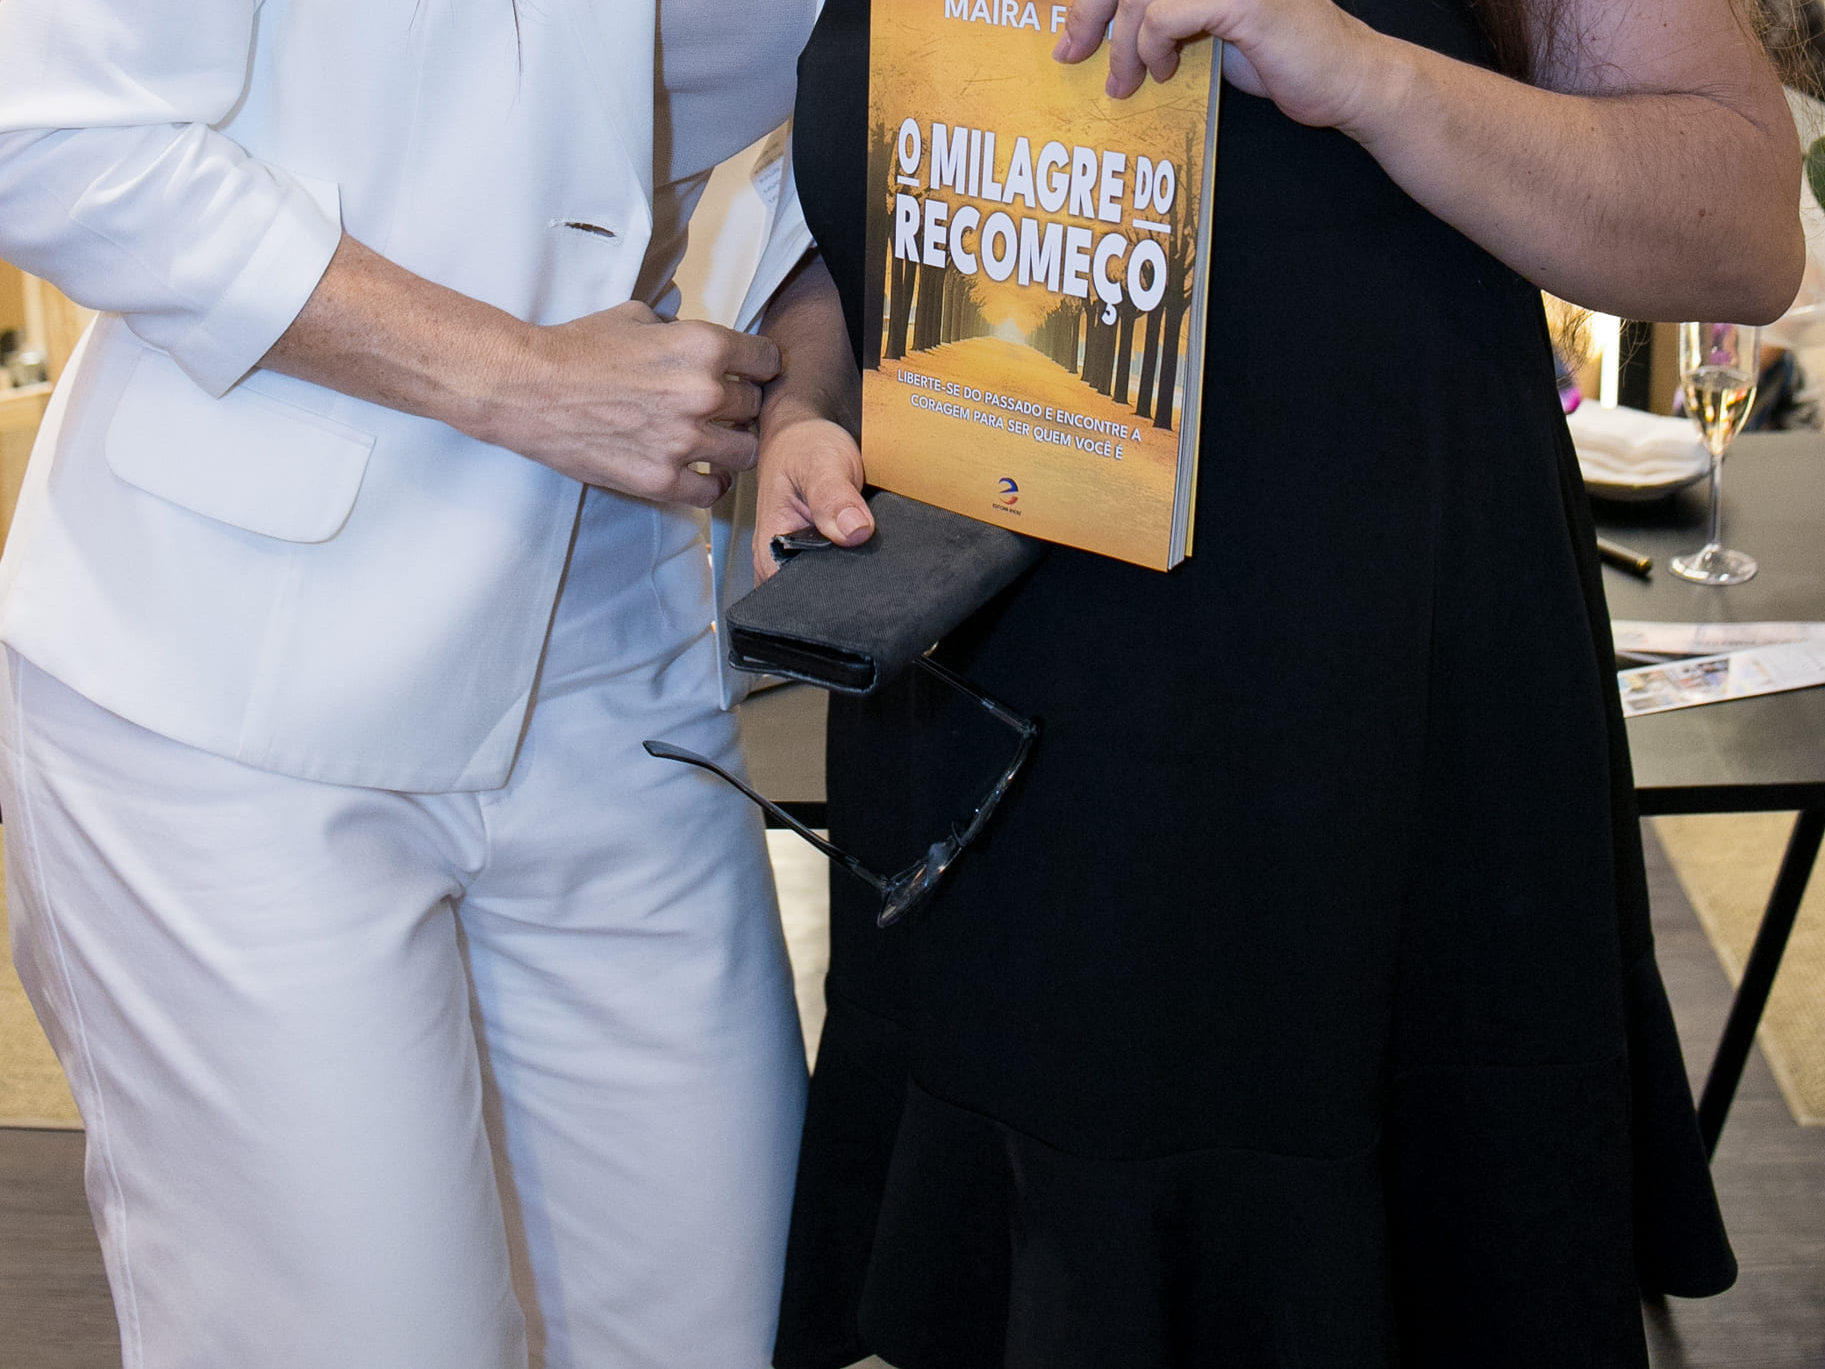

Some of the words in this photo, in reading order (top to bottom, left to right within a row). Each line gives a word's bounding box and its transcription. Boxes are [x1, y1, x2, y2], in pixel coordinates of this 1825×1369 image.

[898, 117, 922, 175] O
[930, 122, 1127, 224] MILAGRE
[1133, 155, 1176, 215] DO
[894, 192, 1168, 326] RECOMEÇO
[897, 369, 960, 398] LIBERTE-SE
[963, 385, 982, 402] DO
[984, 391, 1042, 418] PASSADO
[1044, 406, 1053, 421] E
[1056, 409, 1128, 439] ENCONTRE
[1130, 427, 1142, 442] A
[910, 394, 971, 421] CORAGEM
[973, 411, 1004, 430] PARA
[1007, 419, 1030, 437] SER
[1033, 426, 1071, 447] QUEM
[1074, 436, 1112, 458] VOCÊ
[1114, 443, 1124, 460] É
